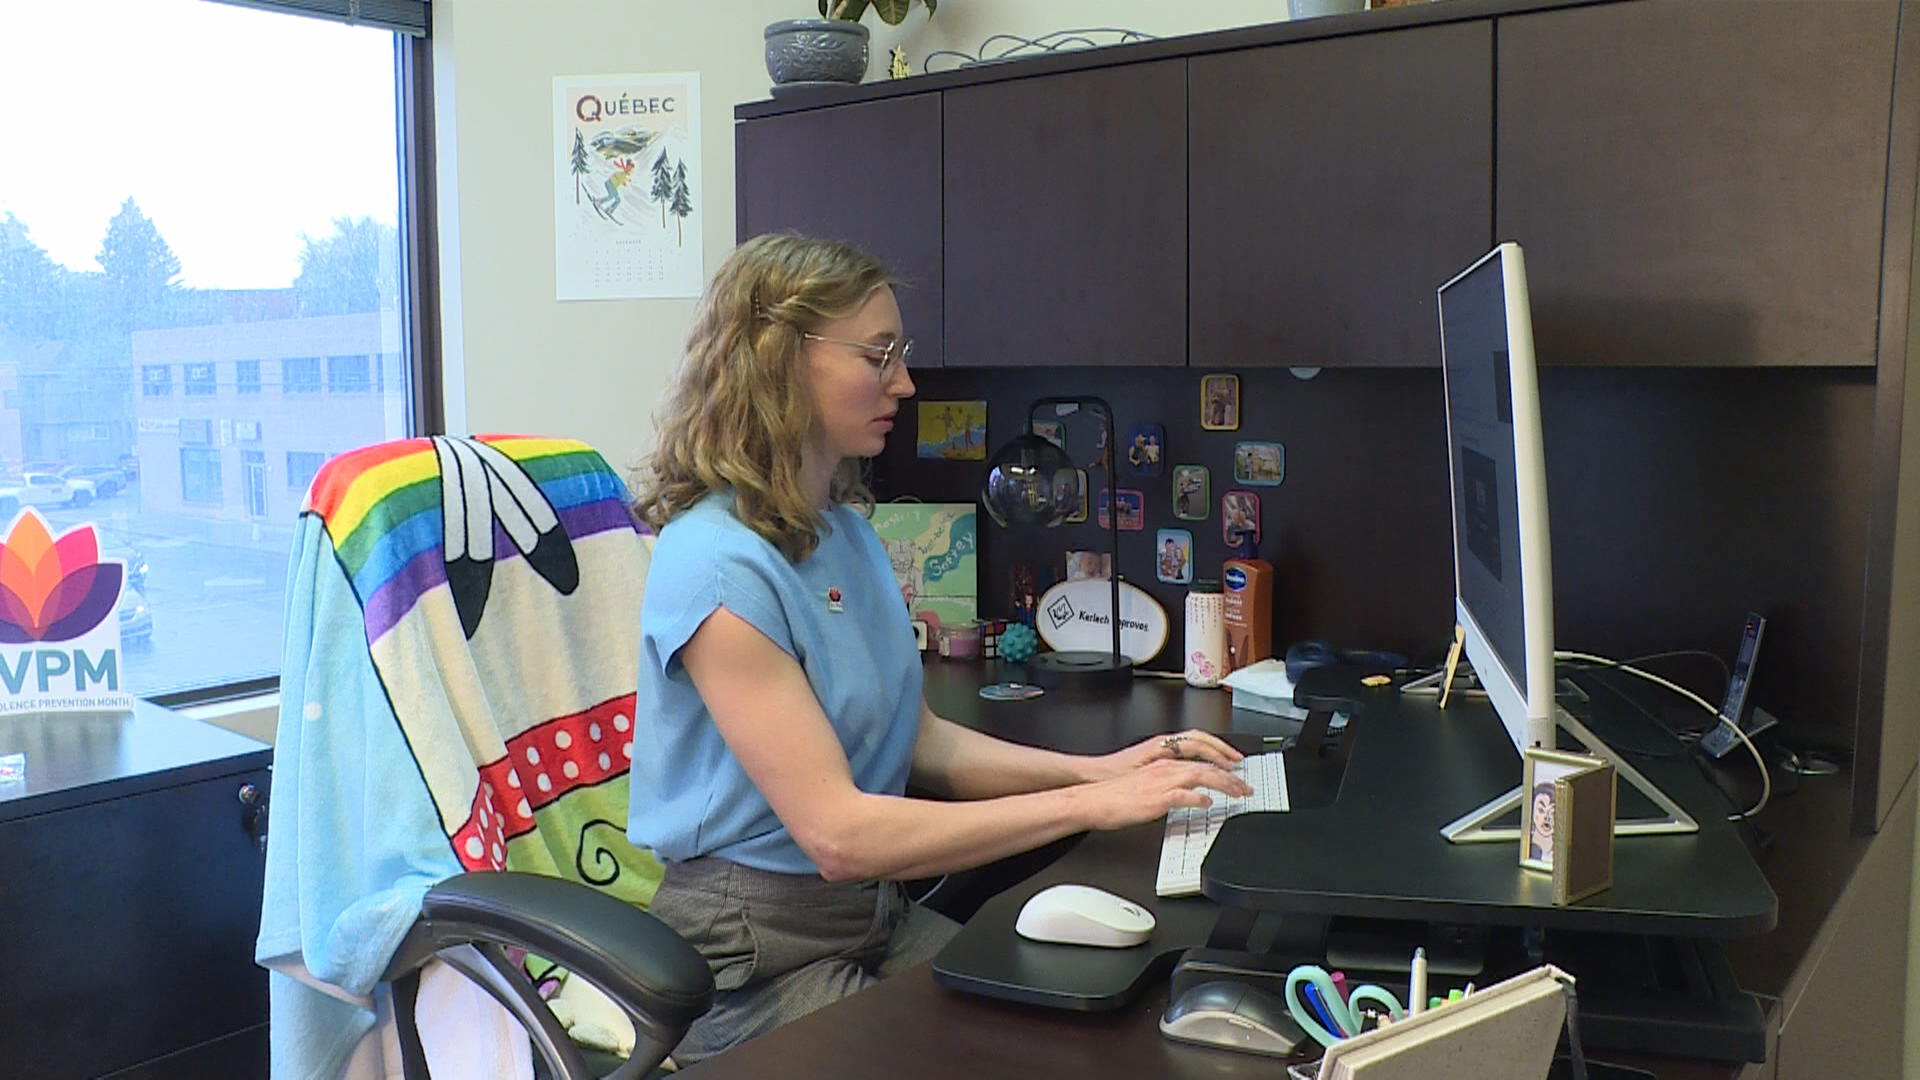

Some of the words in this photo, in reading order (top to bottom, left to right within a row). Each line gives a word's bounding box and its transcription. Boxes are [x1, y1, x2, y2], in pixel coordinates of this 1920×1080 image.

[576, 92, 675, 122] QUÉBEC
[0, 649, 118, 695] VPM
[39, 698, 95, 709] PREVENTION
[97, 697, 129, 707] MONTH
